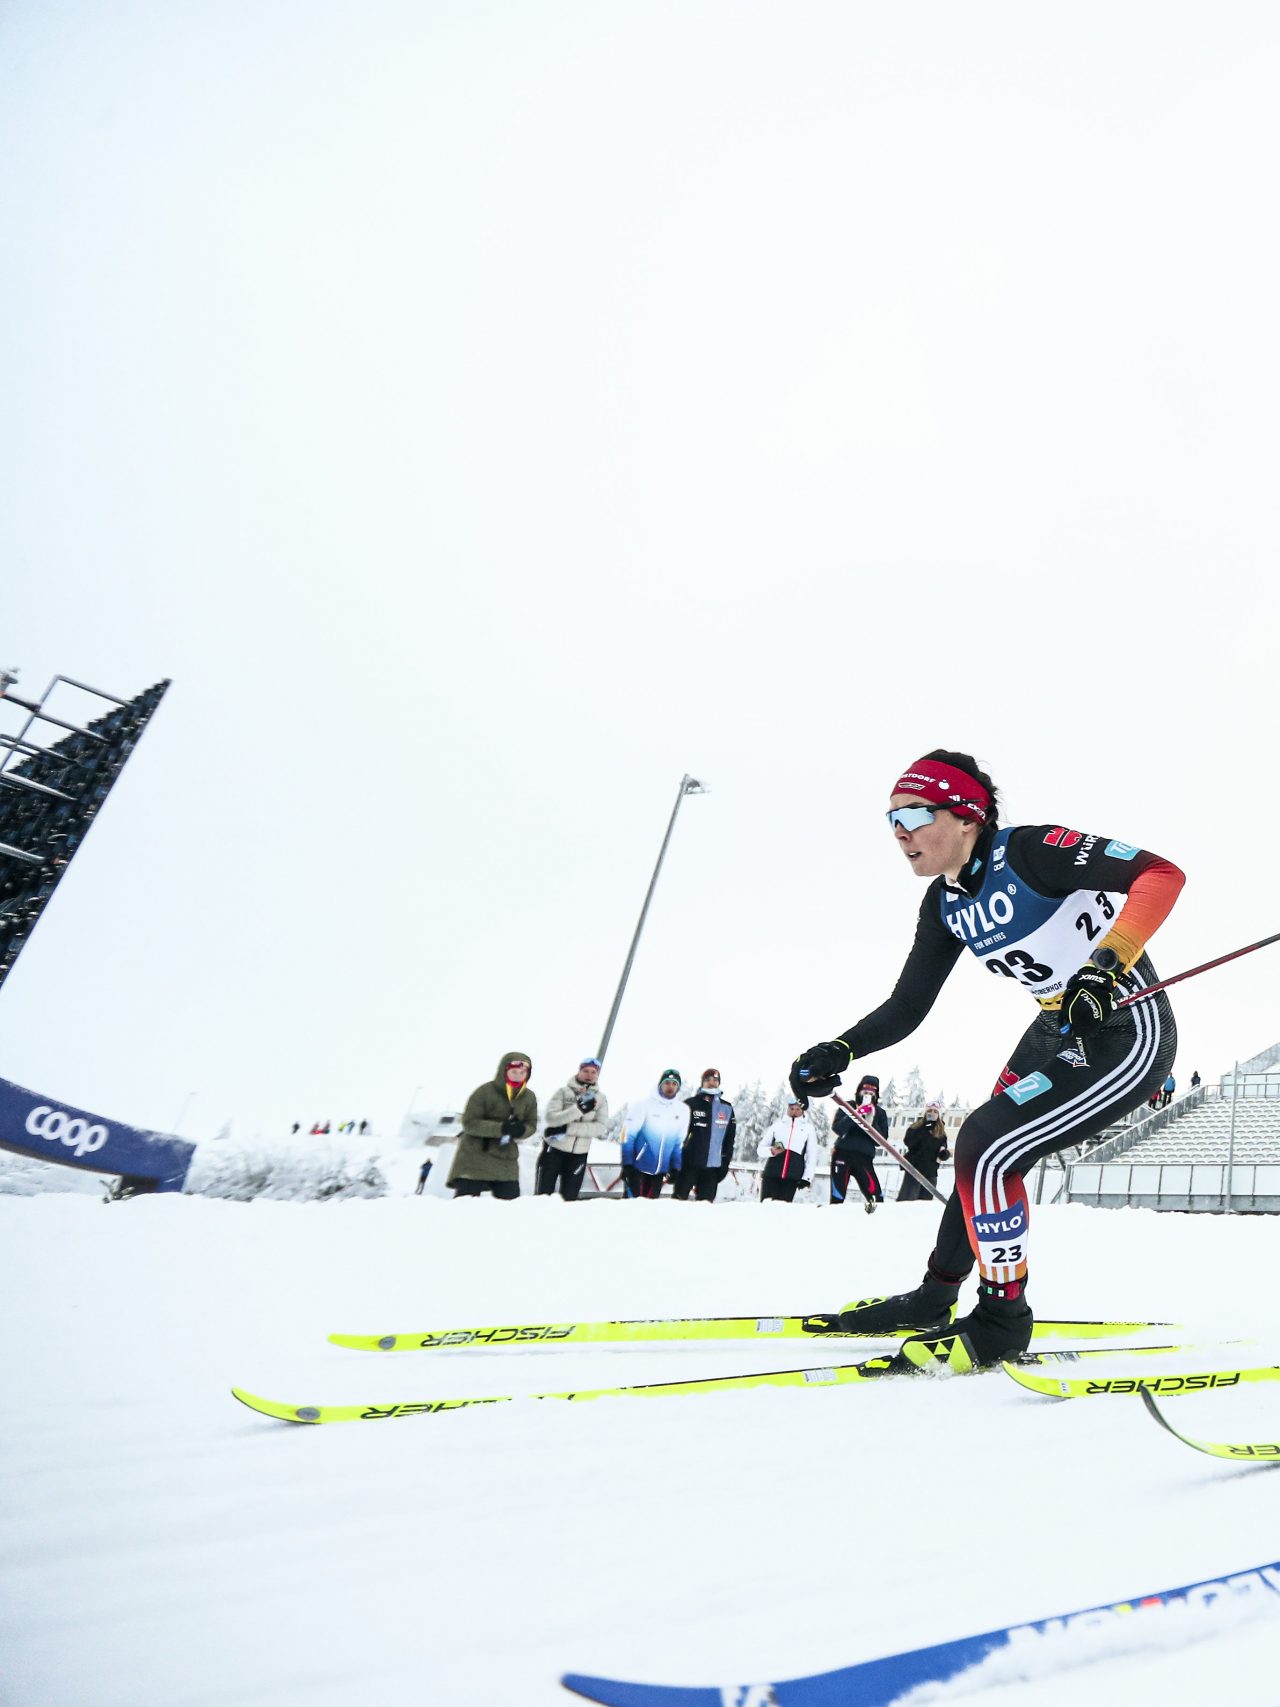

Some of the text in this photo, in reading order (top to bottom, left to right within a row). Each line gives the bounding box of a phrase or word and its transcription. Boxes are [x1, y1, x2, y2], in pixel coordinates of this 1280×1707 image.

[985, 949, 1054, 987] 23
[25, 1105, 110, 1157] coop
[976, 1213, 1023, 1234] HYLO
[991, 1244, 1023, 1265] 23
[420, 1325, 577, 1347] FISCHER
[1086, 1372, 1241, 1395] FISCHER
